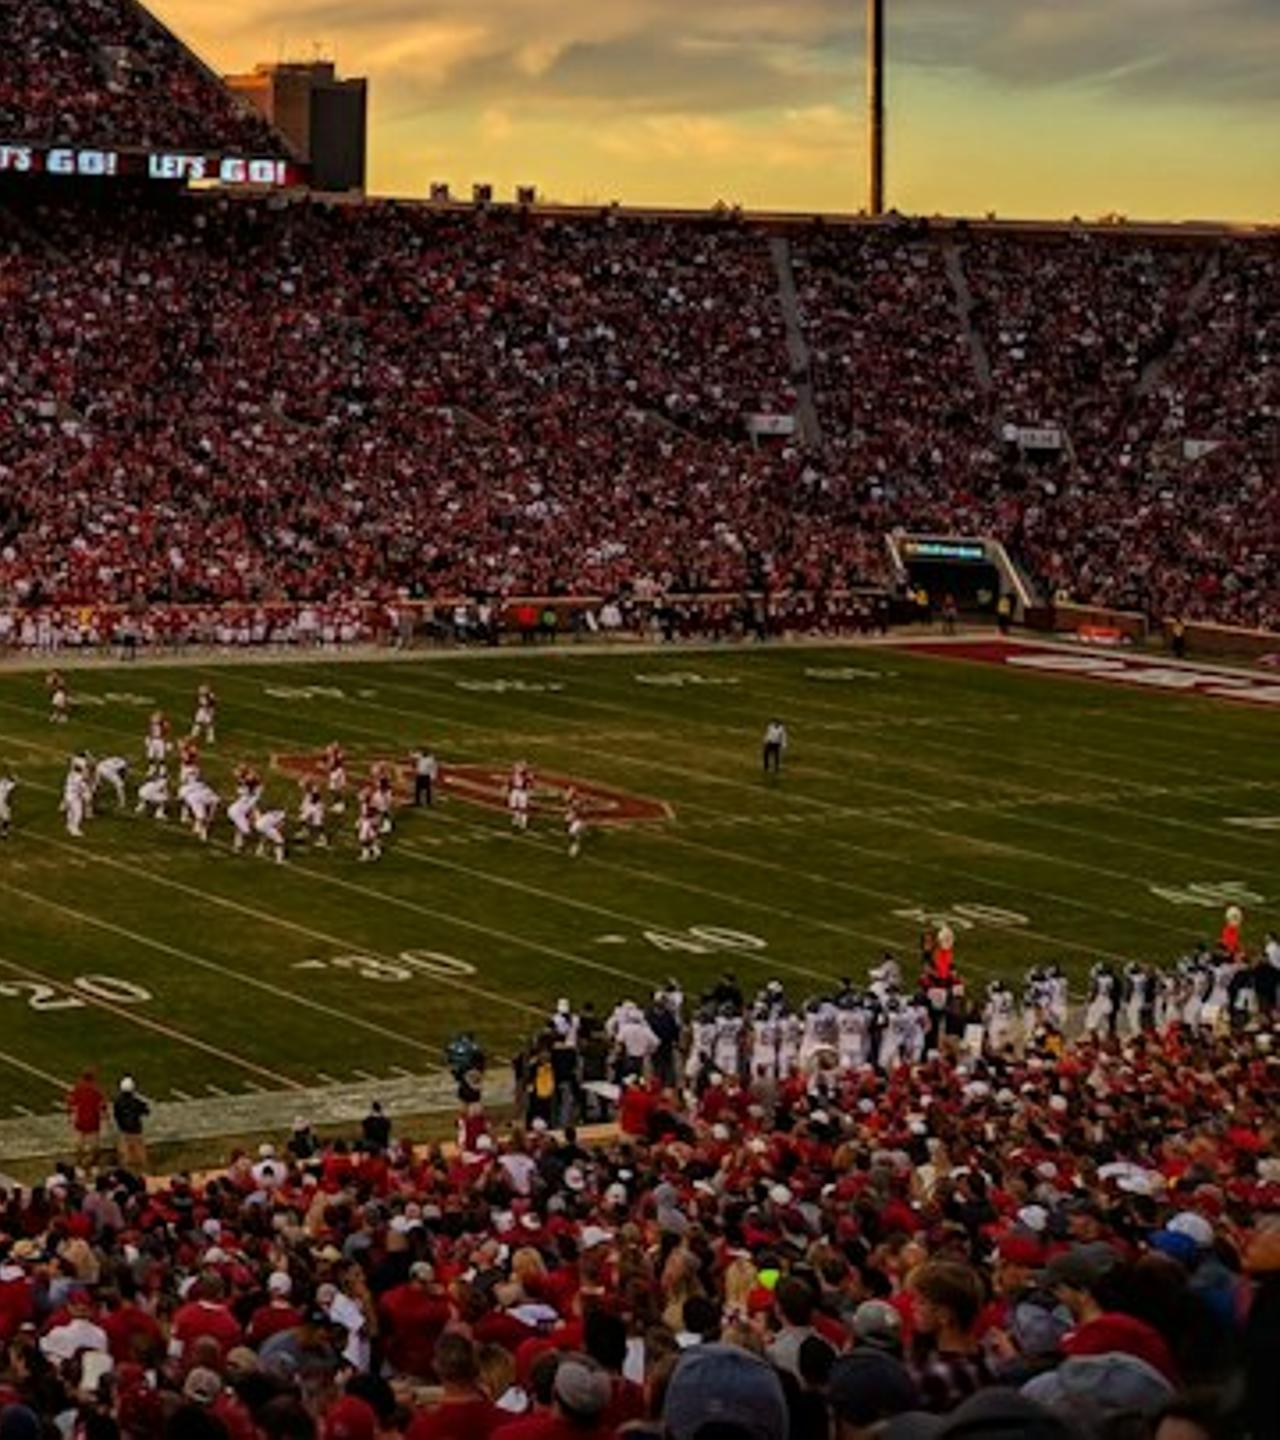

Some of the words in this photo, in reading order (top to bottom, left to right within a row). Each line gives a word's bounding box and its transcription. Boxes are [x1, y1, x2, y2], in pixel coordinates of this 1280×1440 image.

[47, 149, 116, 175] GO!
[149, 154, 206, 180] LET'S
[219, 158, 286, 186] GO!
[330, 950, 478, 982] 30
